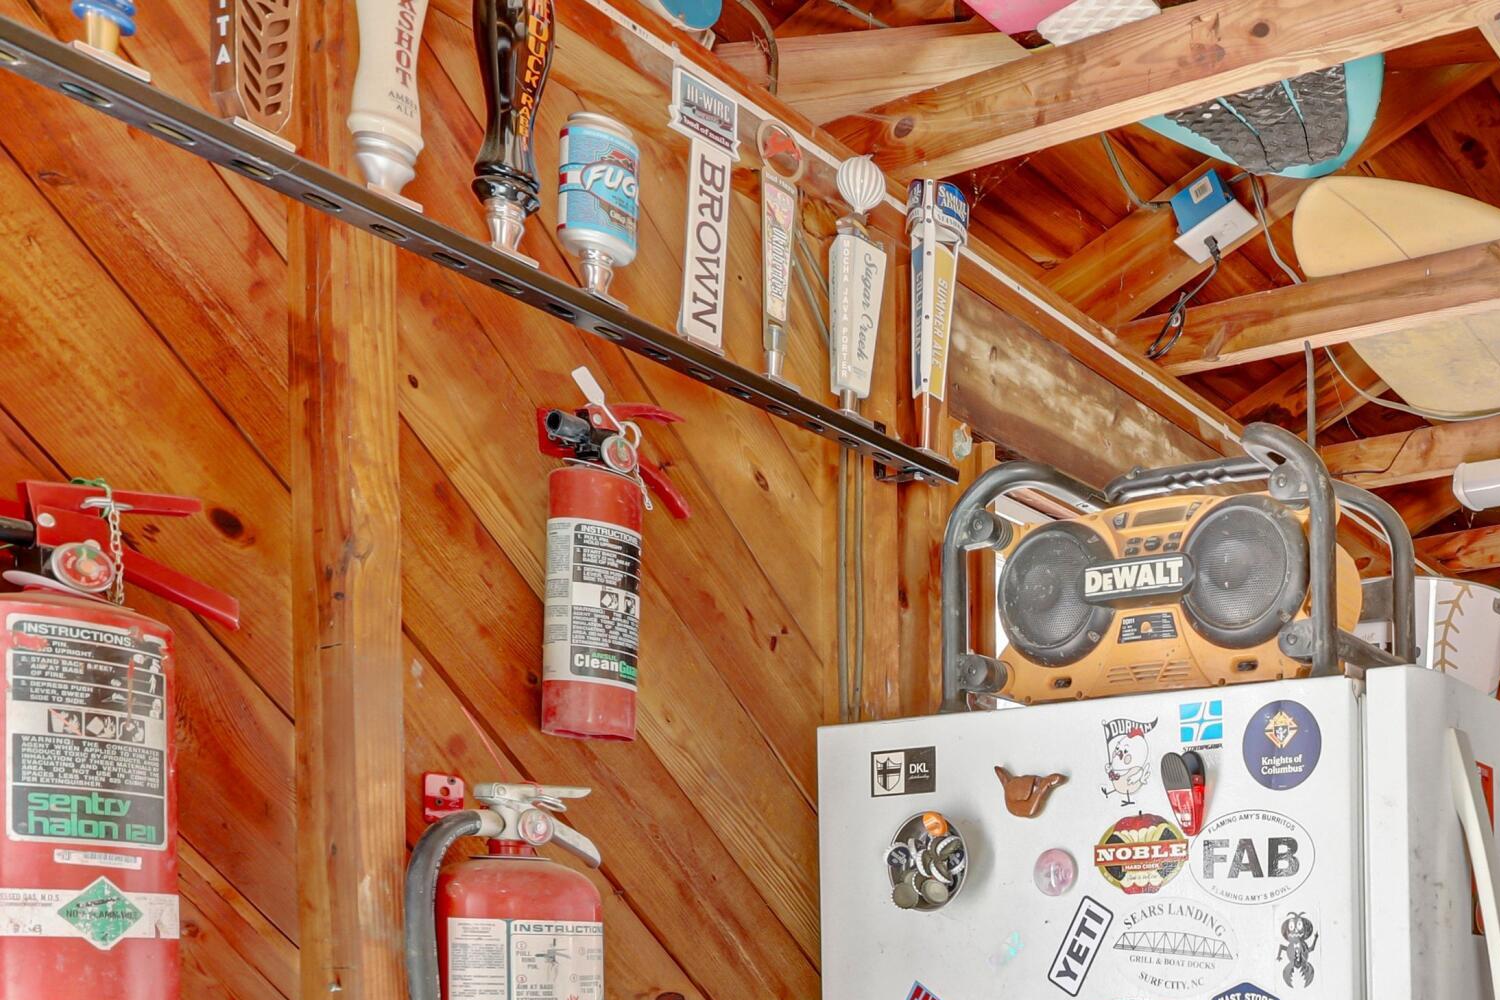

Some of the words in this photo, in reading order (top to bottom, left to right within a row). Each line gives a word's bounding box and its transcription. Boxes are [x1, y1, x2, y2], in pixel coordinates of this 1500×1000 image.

[692, 153, 726, 333] BROWN
[842, 239, 851, 282] MOCHA
[860, 252, 878, 312] Sugar
[841, 290, 850, 321] JAVA
[933, 277, 949, 337] SUMMER
[841, 328, 850, 377] PORTER
[856, 313, 874, 361] Creek
[932, 341, 943, 369] ALE
[1085, 560, 1183, 594] DEWALT
[909, 762, 929, 774] DKL
[1261, 755, 1293, 767] Knights
[1294, 753, 1303, 764] of
[1261, 765, 1303, 776] Columbus
[27, 792, 131, 817] sentry
[28, 810, 119, 839] halon
[1207, 816, 1238, 835] FLAMING
[1262, 813, 1297, 832] BURRITOS
[1096, 843, 1188, 862] NOBLE
[1202, 836, 1300, 879] FAB
[1123, 903, 1165, 930] SEARS
[1167, 903, 1226, 937] LANDING
[1056, 907, 1105, 982] YETI
[1129, 955, 1154, 965] GRILL
[1164, 957, 1186, 967] BOAT
[1187, 960, 1216, 970] DOCKS
[1138, 971, 1164, 987] SURF
